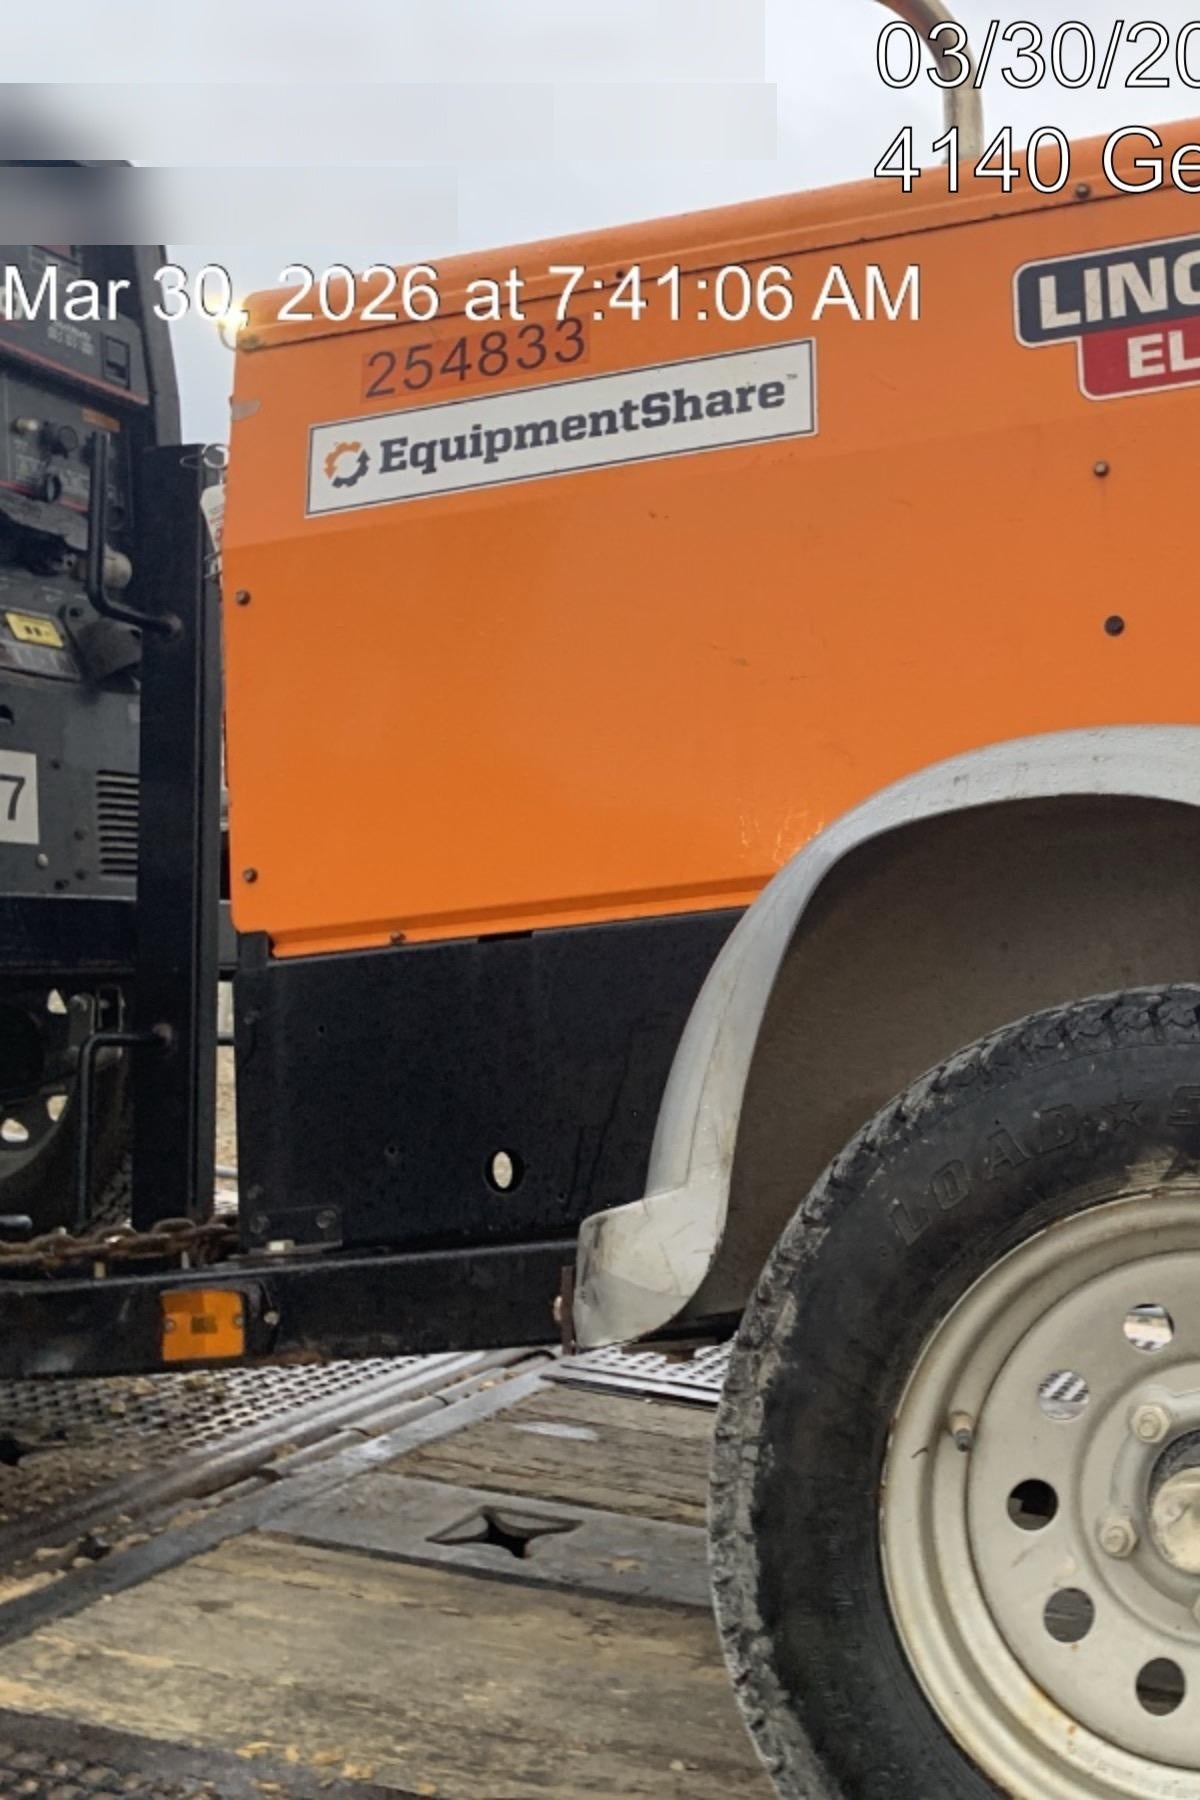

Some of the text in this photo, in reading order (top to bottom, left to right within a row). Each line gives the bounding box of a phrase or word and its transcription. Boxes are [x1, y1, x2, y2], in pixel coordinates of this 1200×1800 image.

[365, 317, 586, 399] 254833
[379, 380, 785, 475] EquipmentShare
[887, 1100, 1081, 1247] LOAD
